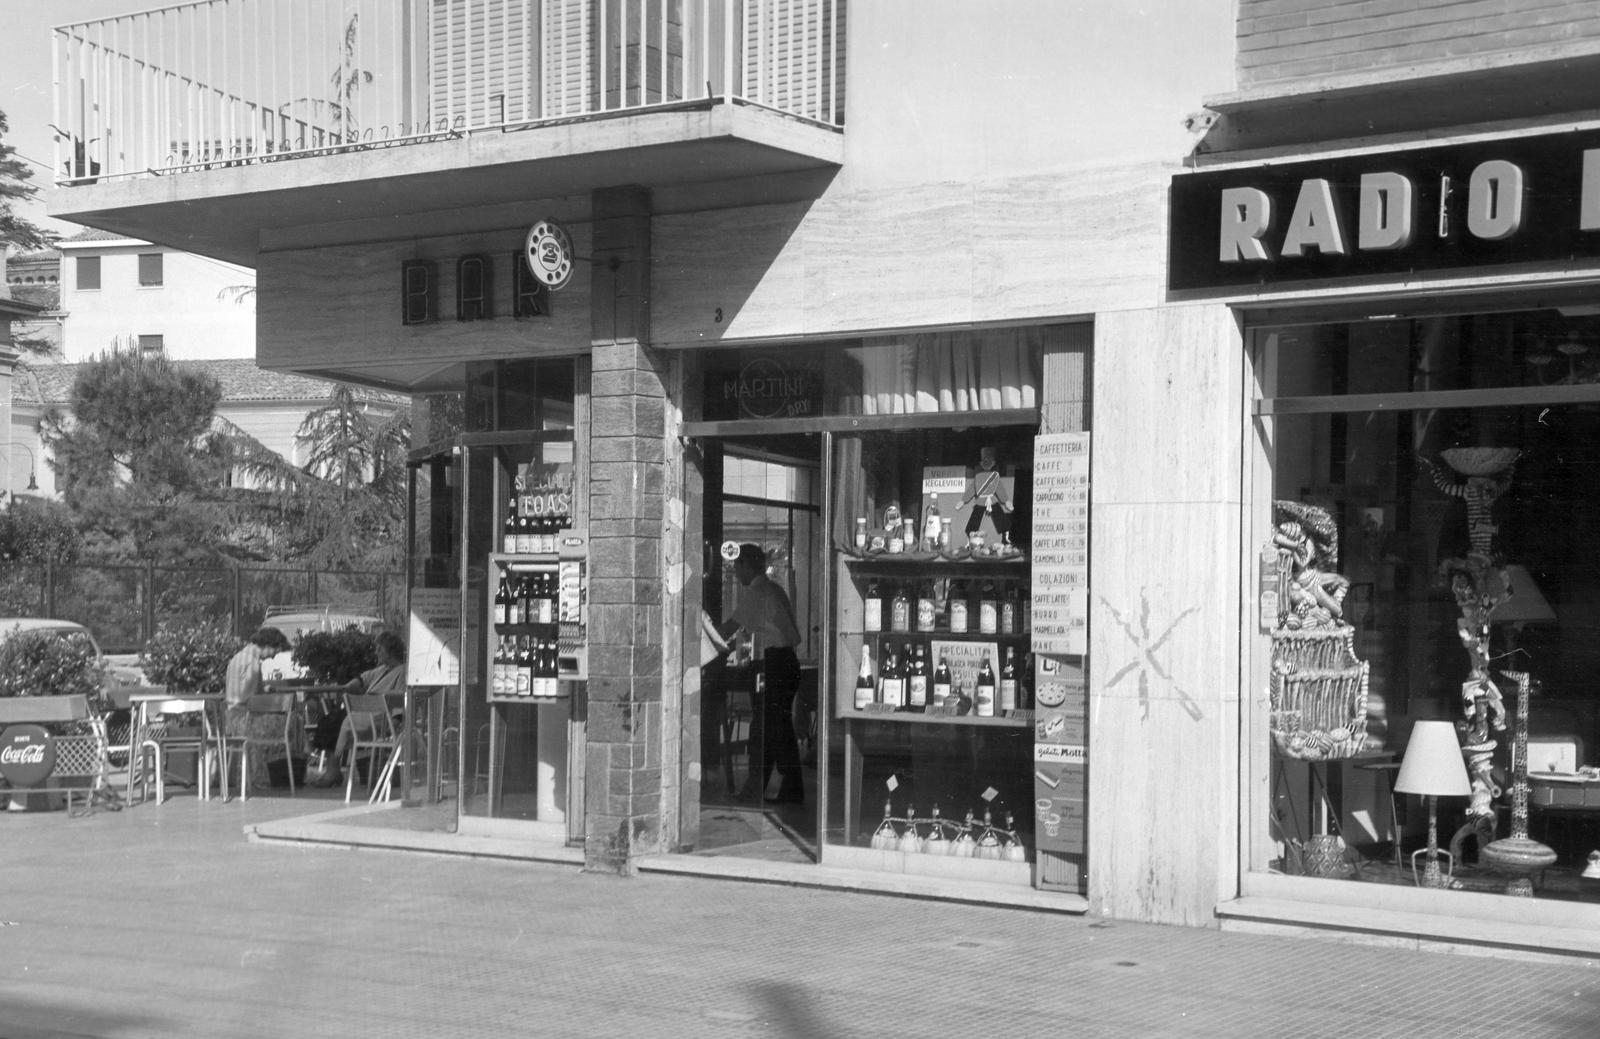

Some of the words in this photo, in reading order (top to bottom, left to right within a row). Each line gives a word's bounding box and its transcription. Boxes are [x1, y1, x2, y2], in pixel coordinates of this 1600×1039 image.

[1219, 159, 1523, 263] RADIO
[402, 250, 549, 326] BAR
[723, 376, 803, 399] MARTINI
[787, 399, 811, 417] DRY
[1039, 442, 1082, 455] CAFFETTERIA
[1039, 573, 1078, 584] COLAZIONI
[1060, 748, 1088, 758] Motta
